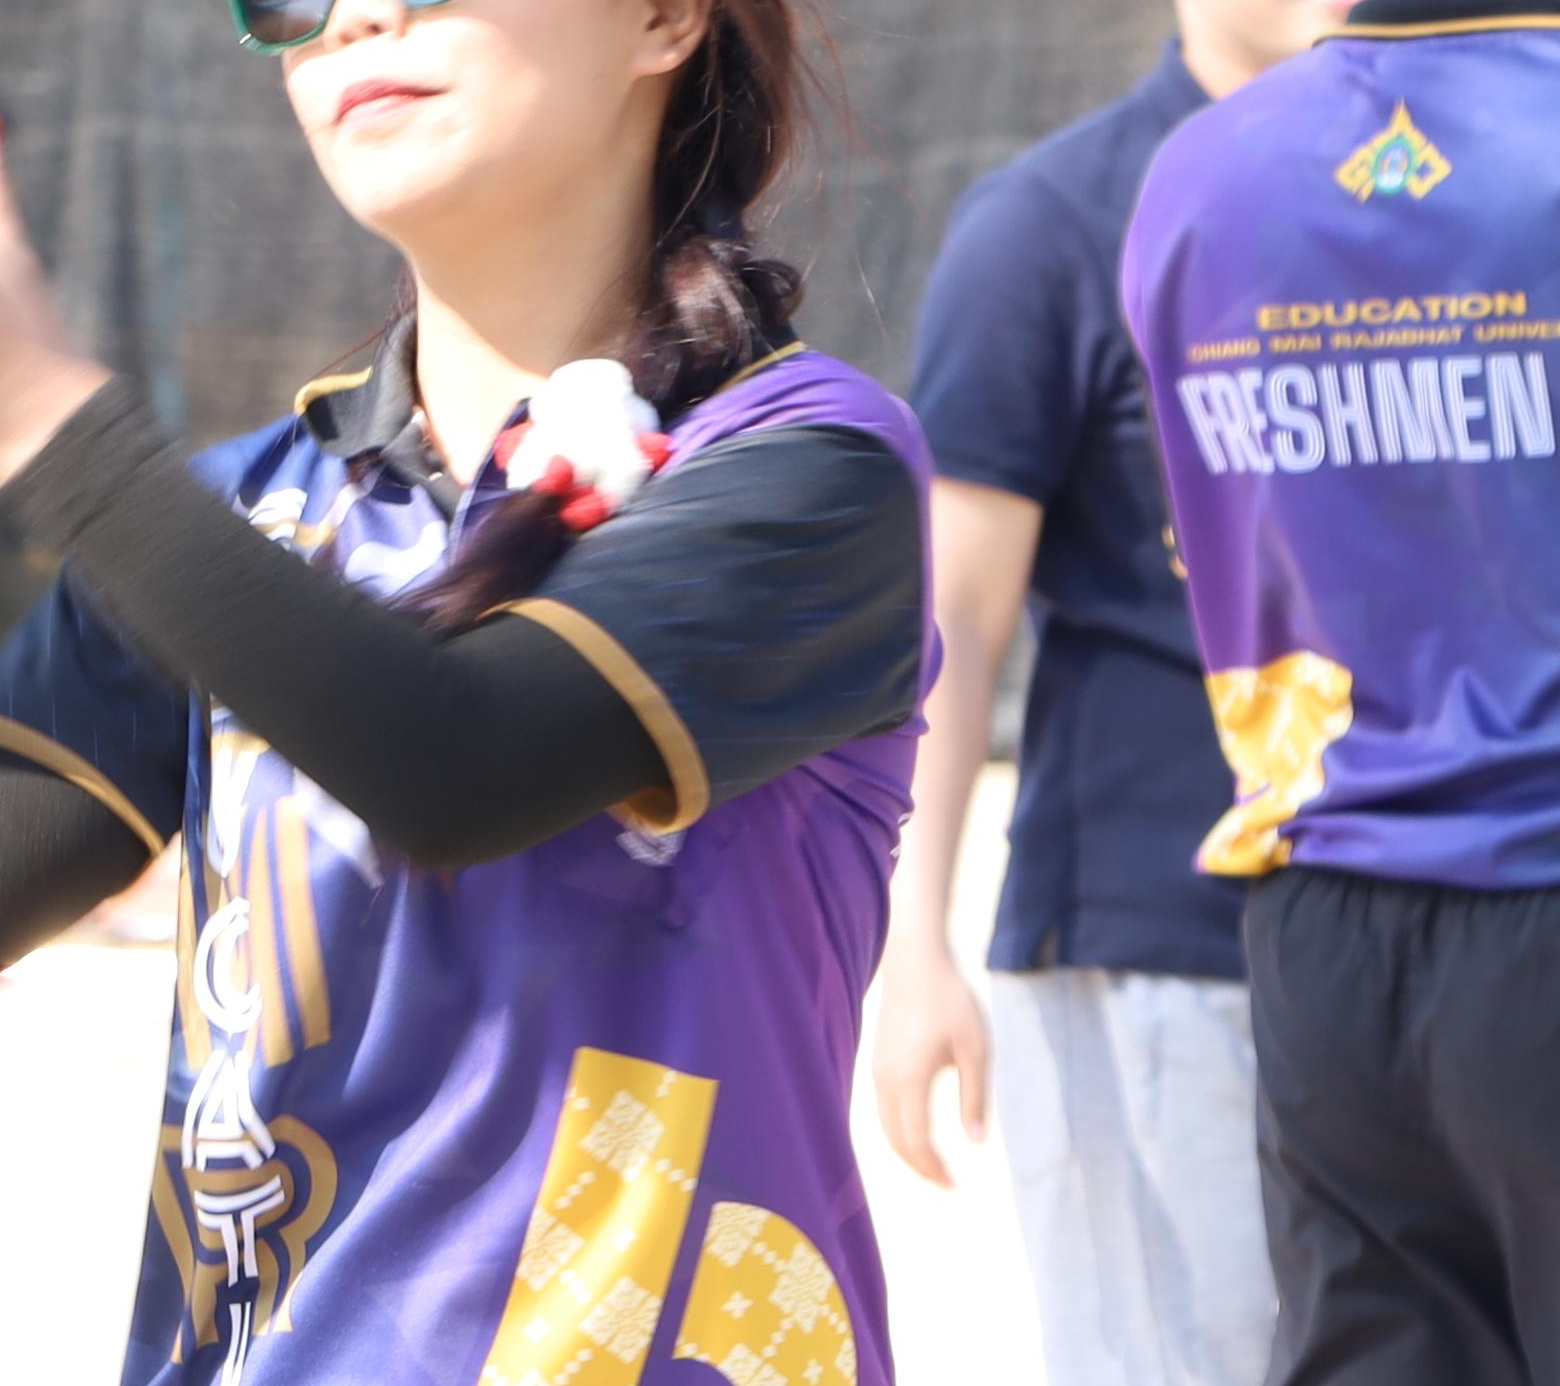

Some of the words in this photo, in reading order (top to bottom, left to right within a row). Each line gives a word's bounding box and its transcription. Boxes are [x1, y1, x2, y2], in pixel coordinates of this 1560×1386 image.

[1255, 290, 1528, 332] EDUCATION
[1186, 335, 1261, 364] CHIANG
[1269, 333, 1322, 354] MAI
[1331, 326, 1465, 351] RAJABHAT
[1176, 350, 1557, 476] FRESHMEN
